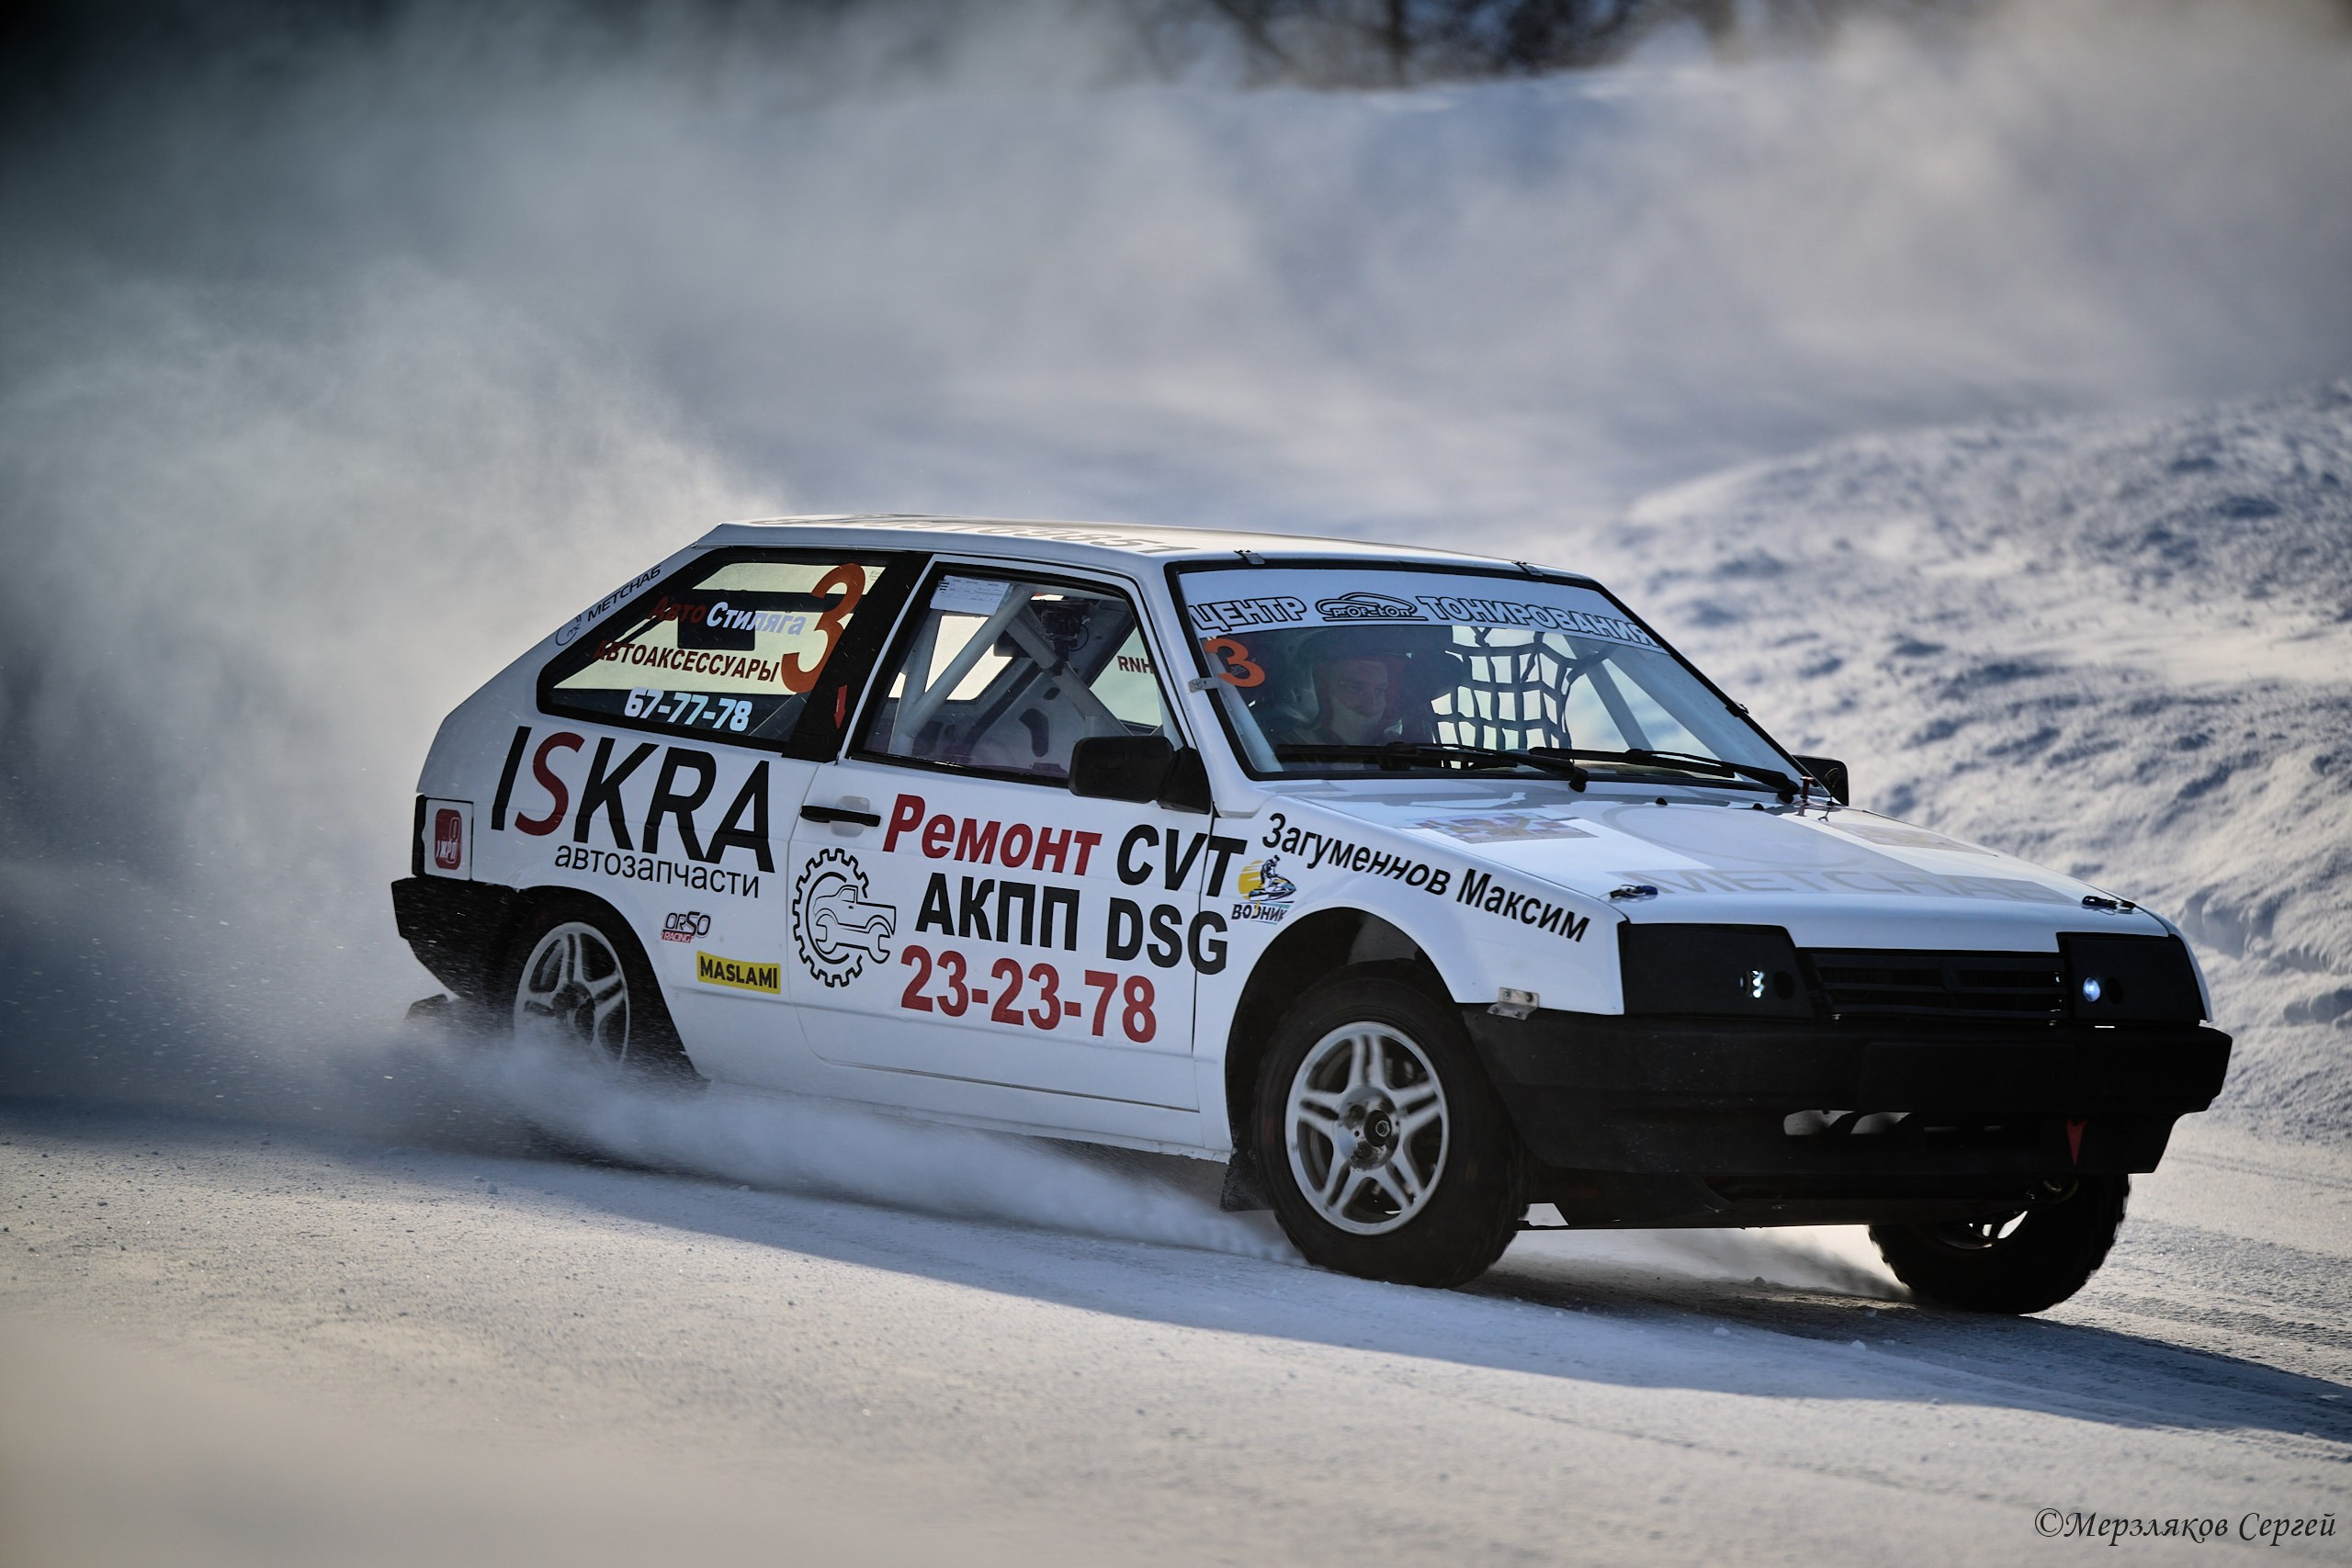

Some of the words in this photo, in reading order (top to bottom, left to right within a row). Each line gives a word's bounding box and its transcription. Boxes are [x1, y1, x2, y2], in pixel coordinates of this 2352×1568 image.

[780, 563, 866, 694] 3
[1189, 597, 1307, 632] ЦЕНТР
[593, 639, 779, 682] АВТОАКСЕССУАРЫ
[1204, 637, 1265, 687] 3
[623, 687, 752, 732] 67-77-78
[492, 726, 775, 874] ISKRA
[554, 845, 761, 899] автозапчасти
[883, 794, 1102, 876] Ремонт
[1116, 824, 1248, 897] CVT
[1262, 812, 1451, 896] Загуменнов
[1455, 868, 1590, 943] Максим
[915, 873, 1080, 952] АКПП
[1106, 897, 1228, 975] DSG
[700, 955, 778, 989] MASLAMI
[900, 944, 1158, 1043] 23-23-78
